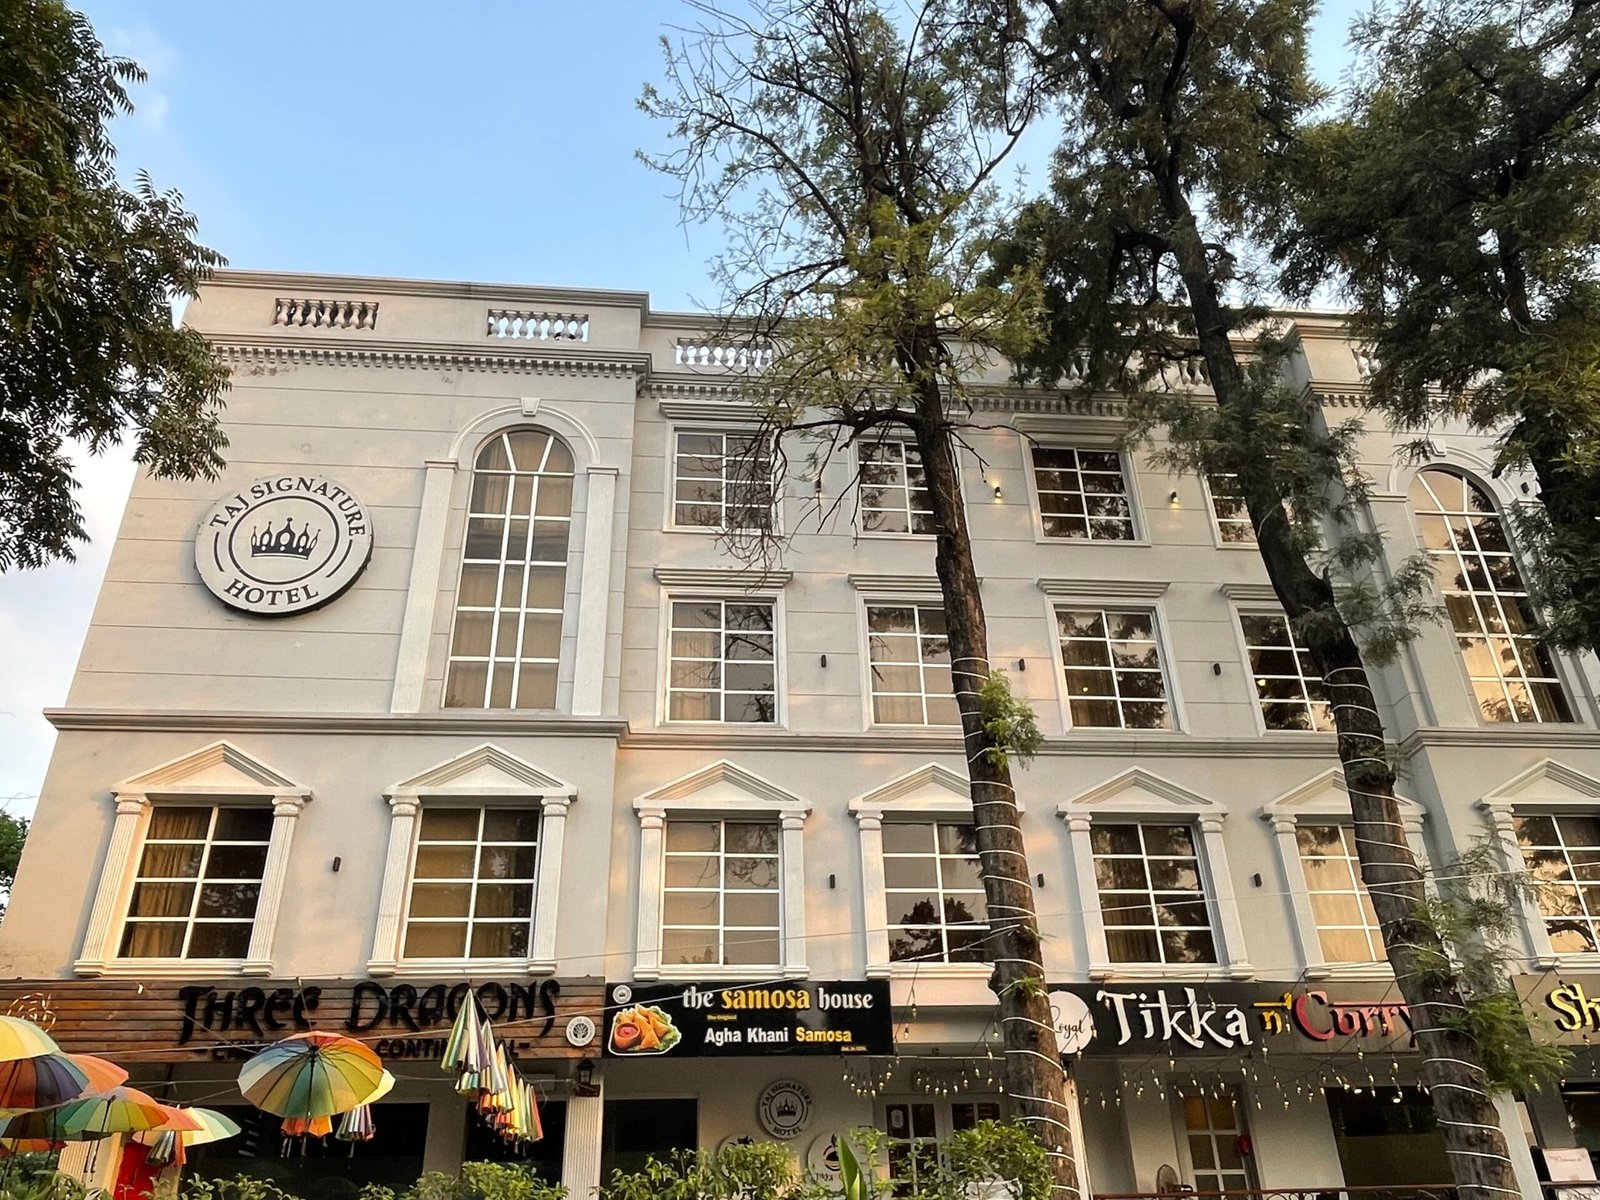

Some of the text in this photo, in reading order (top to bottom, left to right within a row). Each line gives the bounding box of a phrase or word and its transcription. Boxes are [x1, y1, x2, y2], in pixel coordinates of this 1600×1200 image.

[209, 477, 366, 536] TAJ SIGNATURE
[223, 578, 319, 606] HOTEL
[682, 986, 874, 1010] the samosa house
[179, 985, 322, 1045] THREE
[1050, 1005, 1086, 1040] Royal
[1096, 986, 1254, 1049] Tikka
[704, 1027, 852, 1045] Agha Khani Samosa
[772, 1126, 802, 1137] HOTEL
